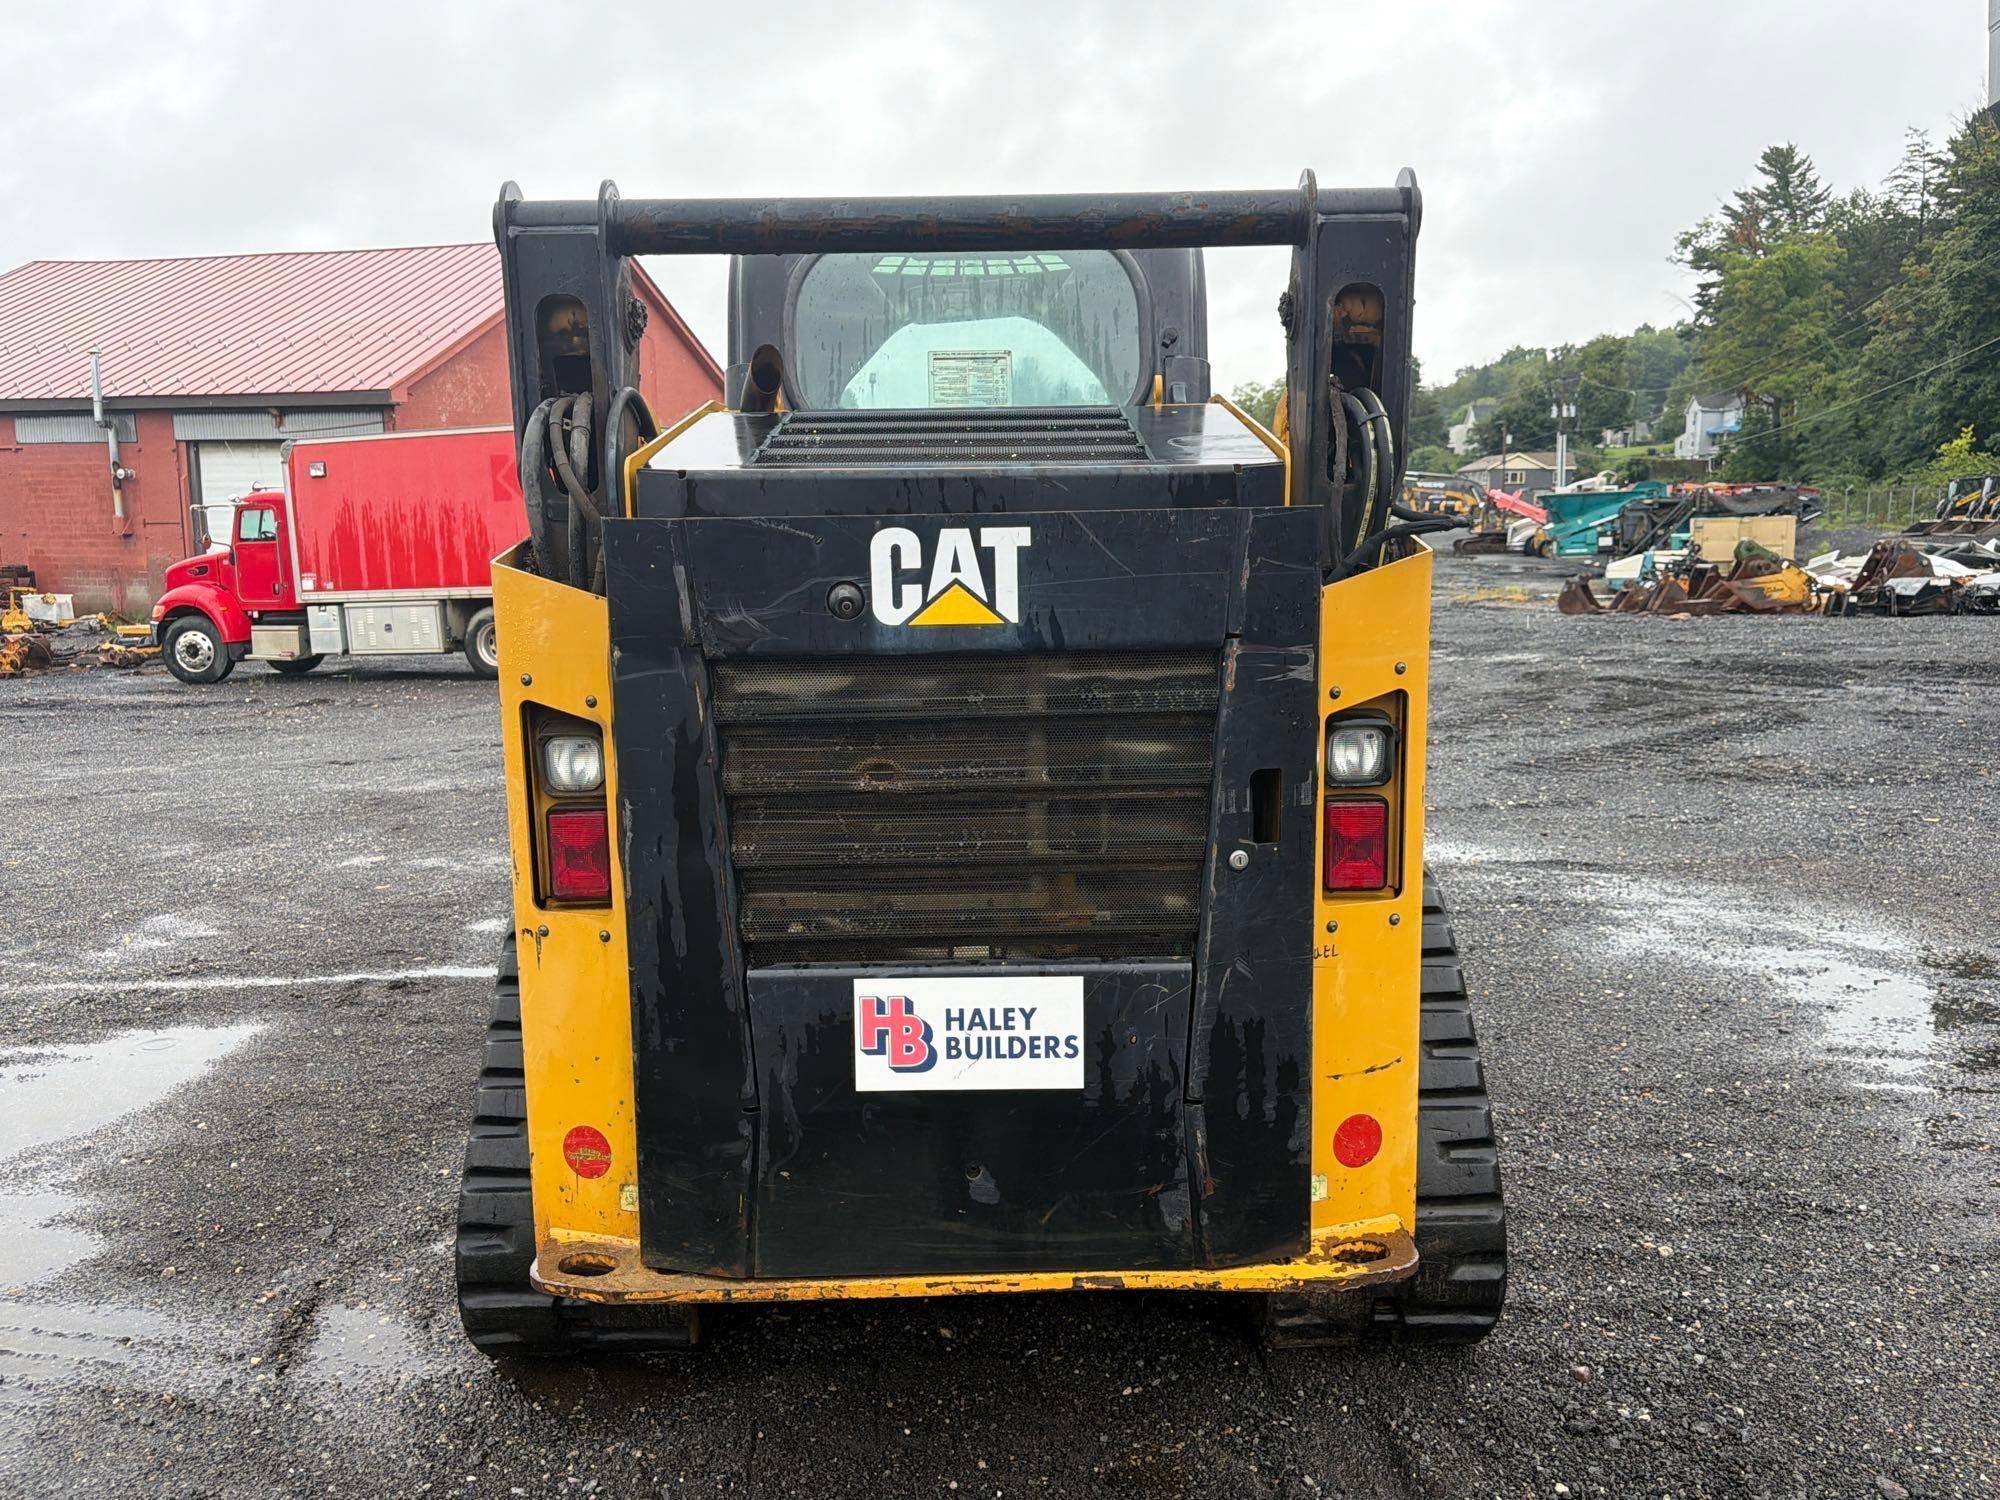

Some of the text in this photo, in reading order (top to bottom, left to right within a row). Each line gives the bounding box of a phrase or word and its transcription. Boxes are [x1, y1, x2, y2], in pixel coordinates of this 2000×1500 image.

[870, 527, 1032, 626] CAT
[859, 995, 938, 1073] HB
[945, 1007, 1038, 1031] HALEY
[945, 1035, 1079, 1060] BUILDERS
